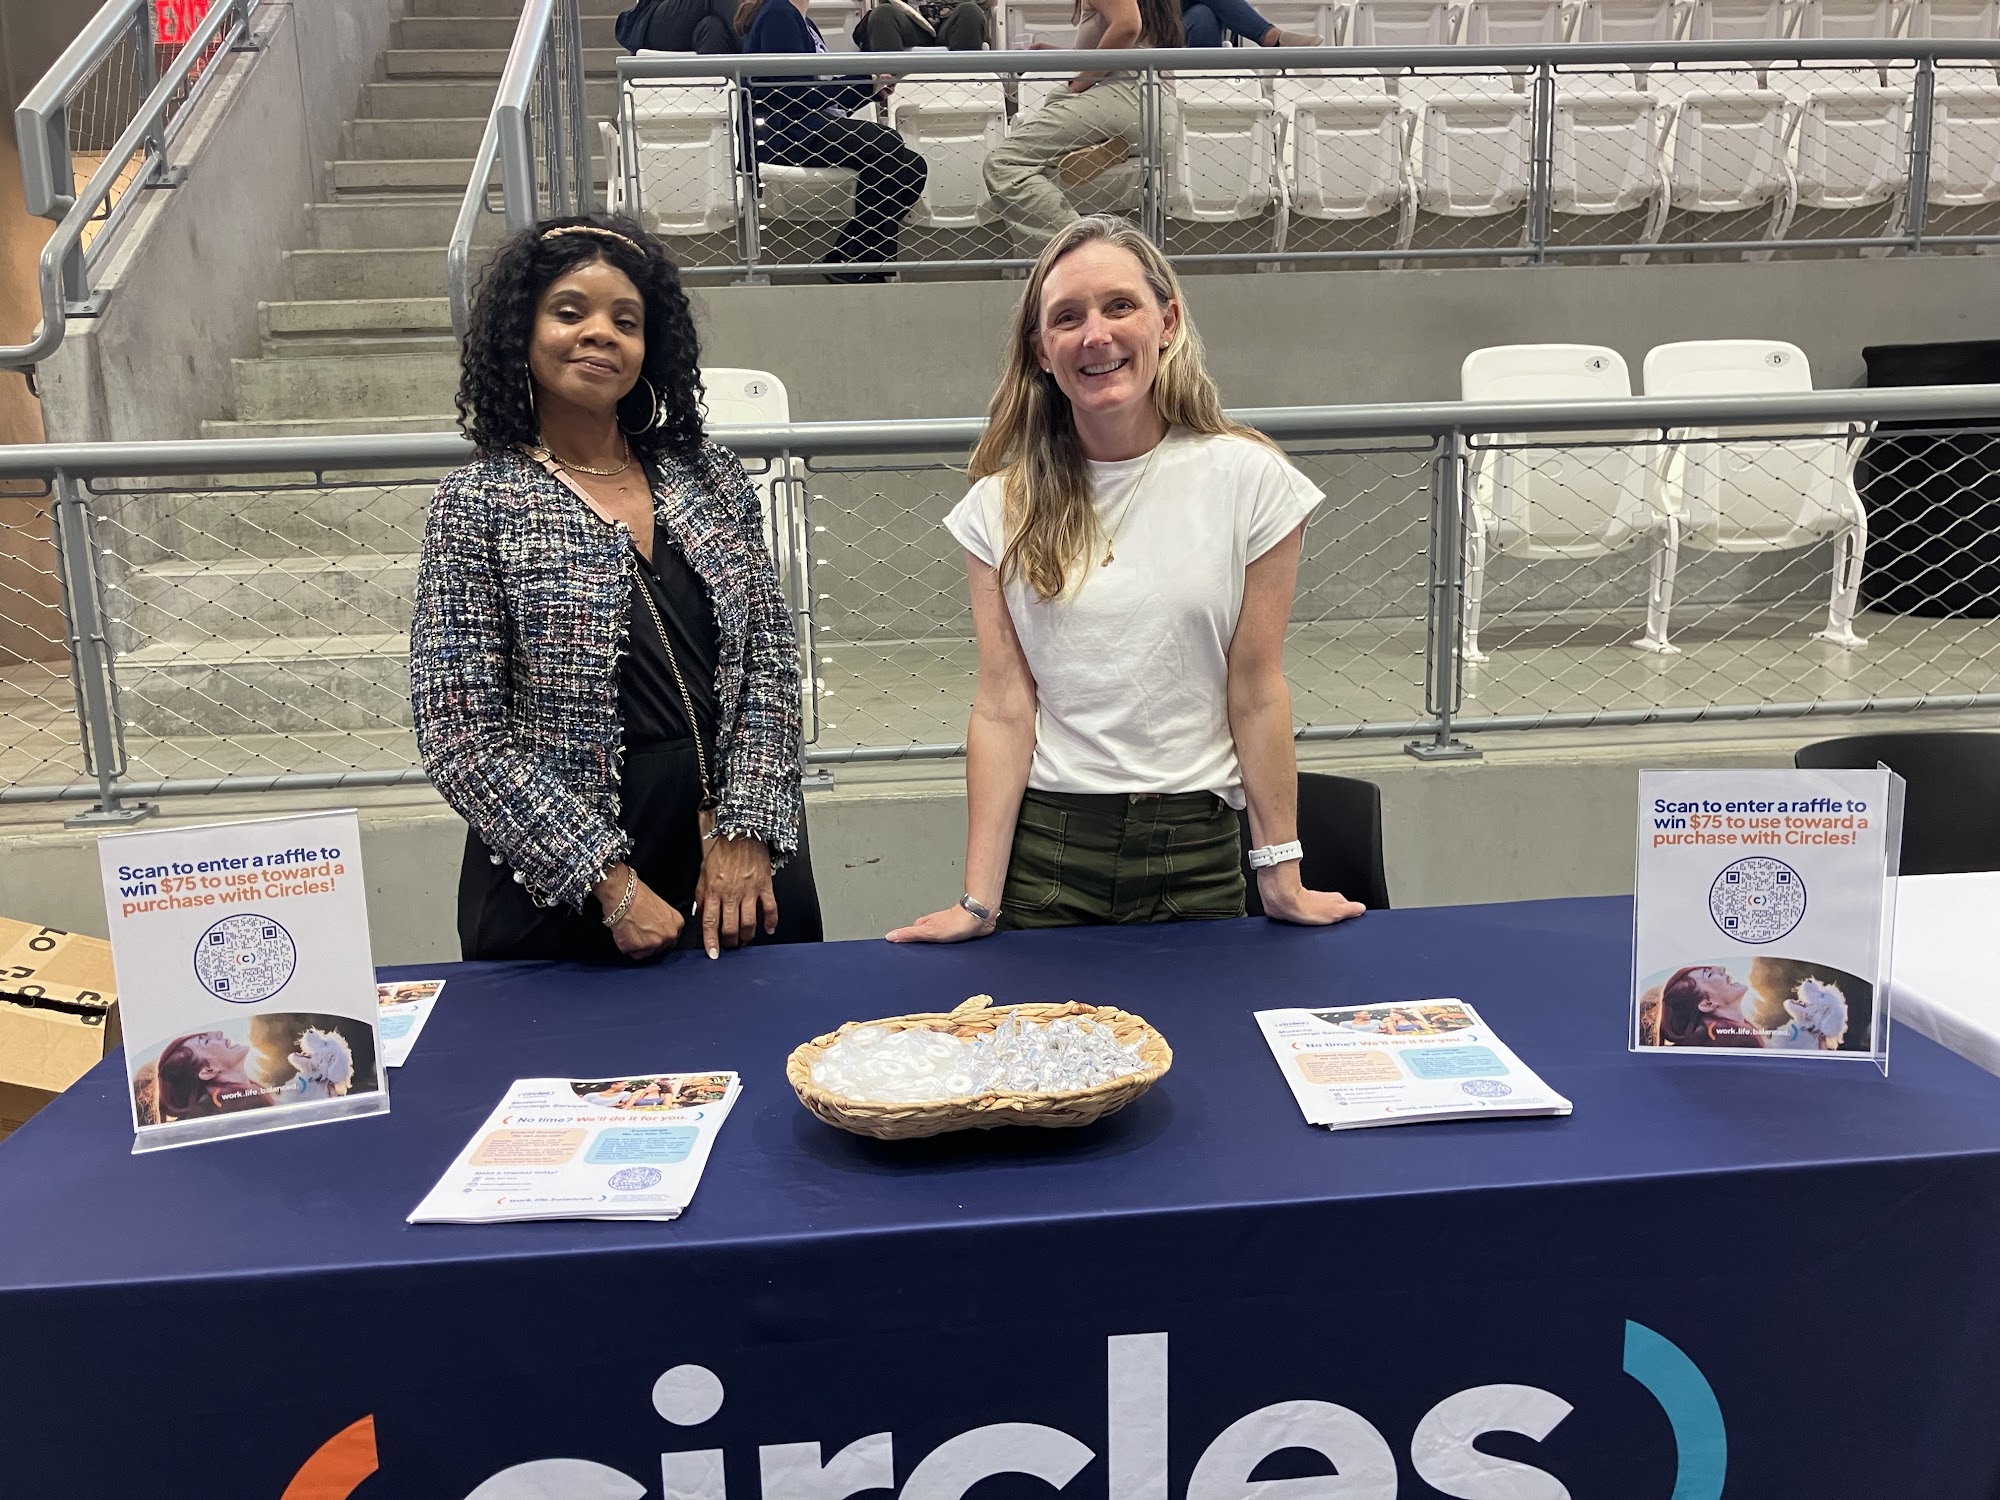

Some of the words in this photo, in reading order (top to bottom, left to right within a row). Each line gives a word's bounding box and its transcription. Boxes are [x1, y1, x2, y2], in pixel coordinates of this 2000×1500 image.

[1593, 360, 1601, 368] 4
[1774, 356, 1782, 364] 5
[1654, 799, 1699, 813] Scan
[1702, 800, 1723, 813] to
[1725, 800, 1775, 813] enter
[1777, 802, 1788, 813] a
[1791, 797, 1843, 813] raffle
[1846, 799, 1867, 813] to
[1654, 816, 1686, 829] win
[1689, 814, 1722, 830] $75
[1726, 816, 1745, 829] to
[1748, 817, 1781, 829] use
[1784, 814, 1854, 829] toward
[1857, 817, 1869, 829] a
[1653, 831, 1737, 848] purchase
[1740, 830, 1782, 845] with
[1785, 830, 1857, 845] Circles!
[118, 864, 169, 881] Scan
[172, 861, 194, 876] to
[197, 857, 249, 873] enter
[252, 855, 264, 867] a
[267, 847, 317, 865] raffle
[321, 847, 341, 860] to
[120, 881, 157, 898] win
[160, 876, 197, 894] $75
[200, 875, 222, 890] to
[224, 871, 259, 887] use
[262, 862, 331, 883] toward
[334, 863, 345, 875] a
[122, 892, 215, 917] purchase
[219, 886, 262, 904] with
[265, 878, 336, 899] Circles!
